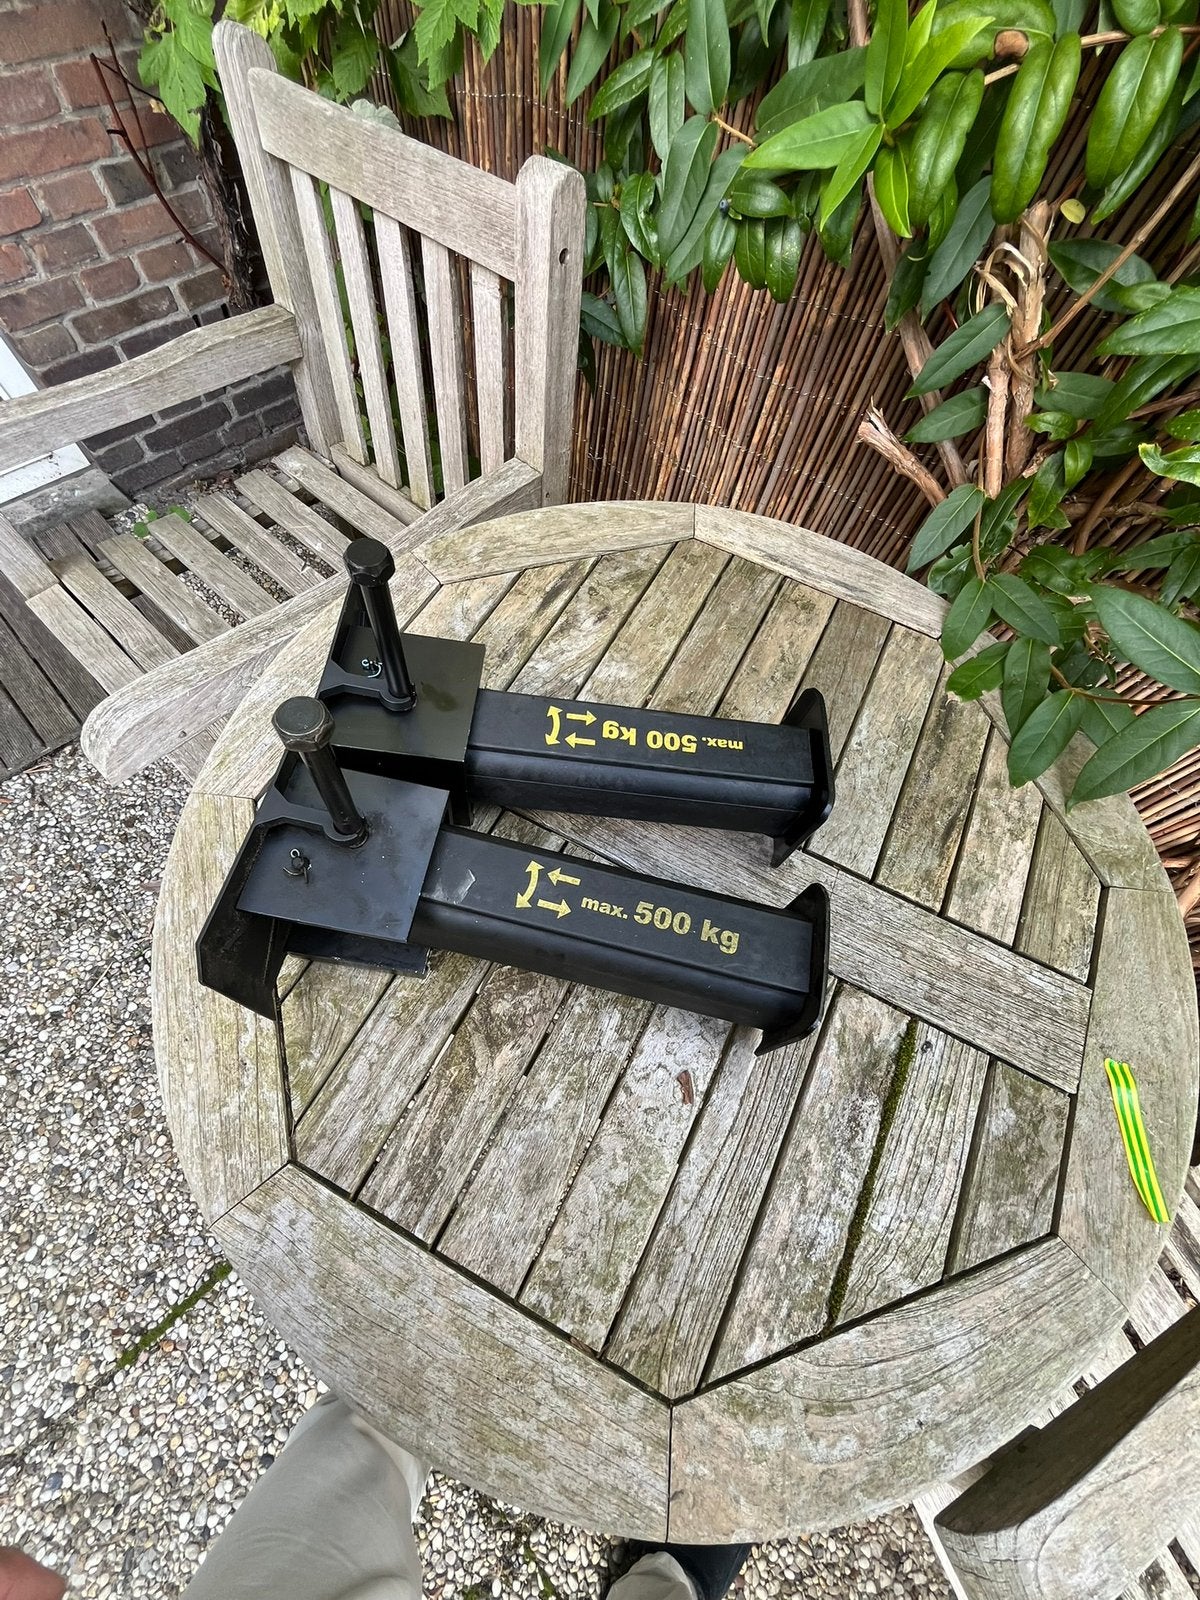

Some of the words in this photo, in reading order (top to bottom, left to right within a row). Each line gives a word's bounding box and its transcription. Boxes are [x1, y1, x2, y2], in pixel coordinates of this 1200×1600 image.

[602, 720, 637, 746] kg
[646, 730, 698, 753] 500
[701, 736, 744, 751] max.
[580, 896, 628, 920] max.
[633, 901, 692, 935] 500
[700, 919, 740, 955] kg
